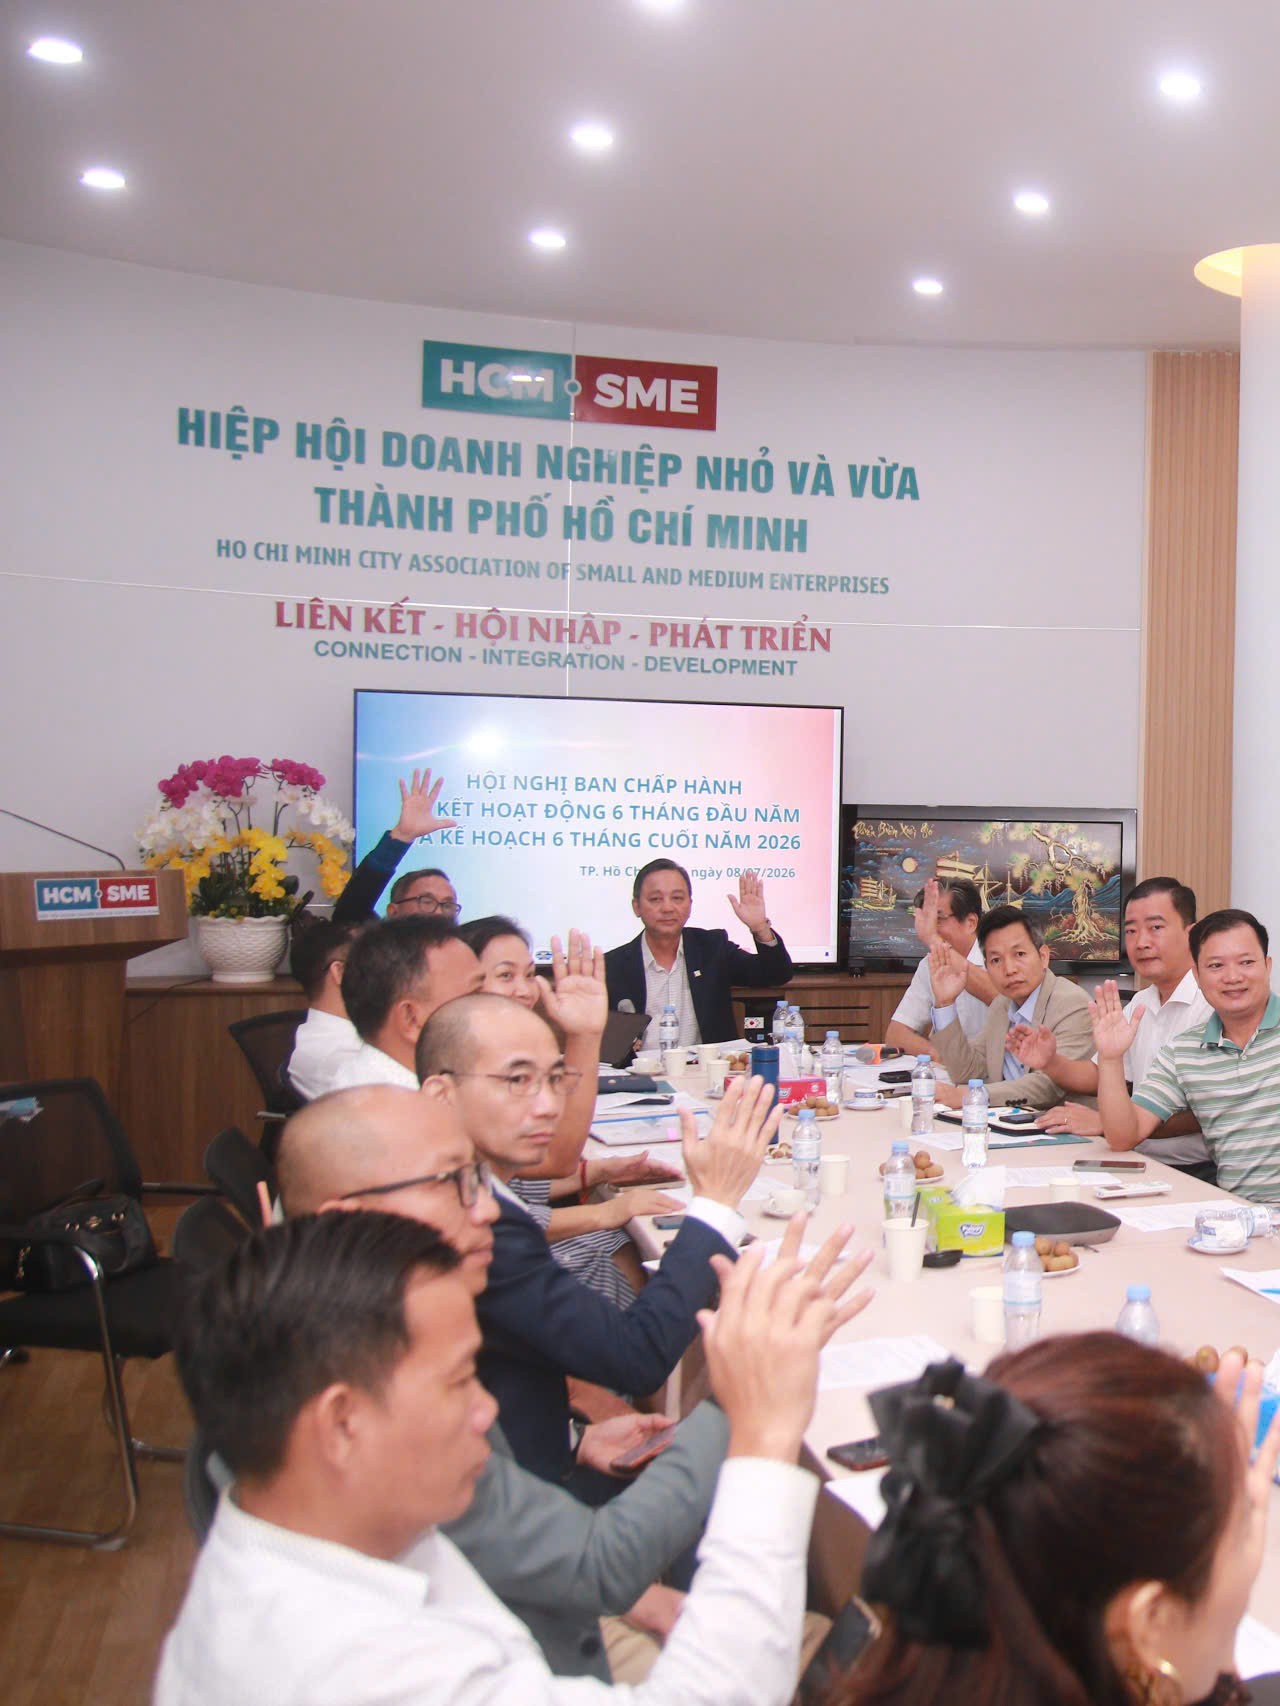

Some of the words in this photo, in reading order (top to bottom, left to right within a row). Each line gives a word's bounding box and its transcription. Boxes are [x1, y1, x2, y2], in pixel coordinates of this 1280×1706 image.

[440, 358, 555, 402] HCM
[593, 373, 699, 415] SME
[177, 405, 280, 460] HIỆP
[296, 417, 366, 472] HỘI
[382, 430, 522, 478] DOANH
[536, 443, 683, 494] NGHIỆP
[696, 446, 774, 494] NHỎ
[788, 454, 835, 497] VÀ
[848, 457, 920, 501] VỪA
[314, 482, 453, 533] THÀNH
[468, 493, 551, 538] PHỐ
[563, 495, 615, 542] HỒ
[628, 505, 694, 546] CHÍ
[706, 513, 808, 553] MINH
[217, 539, 246, 559] HO
[253, 542, 289, 563] CHI
[296, 546, 350, 567] MINH
[358, 550, 403, 571] CITY
[408, 554, 540, 579] ASSOCIATION
[546, 562, 570, 580] OF
[576, 564, 637, 584] SMALL
[642, 566, 683, 586] AND
[689, 569, 764, 590] MEDIUM
[769, 573, 890, 594] ENTERPRISES
[275, 596, 353, 633] LIÊN
[363, 596, 427, 636] KẾT
[455, 607, 519, 646] HỘI
[528, 611, 622, 650] NHẬP
[649, 616, 736, 650] PHÁT
[740, 614, 832, 652] TRIỂN
[314, 640, 463, 664] CONNECTION
[482, 648, 625, 671] INTEGRATION
[645, 655, 798, 676] DEVELOPMENT
[467, 770, 506, 793] HỘI
[513, 775, 568, 795] NGHỊ
[574, 776, 617, 793] BAN
[624, 773, 678, 794] CHẤP
[684, 776, 743, 795] HÀNH
[437, 796, 474, 817] KẾT
[481, 802, 539, 822] HOẠT
[544, 800, 606, 823] ĐỘNG
[612, 804, 624, 820] 6
[629, 802, 700, 821] THÁNG
[705, 802, 748, 822] ĐẦU
[754, 804, 800, 823] NĂM
[440, 825, 467, 845] KẾ
[472, 830, 546, 850] HOẠCH
[552, 831, 564, 847] 6
[570, 828, 641, 848] THÁNG
[648, 828, 698, 848] CUỐI
[705, 830, 751, 849] NĂM
[757, 834, 800, 849] 2026
[580, 866, 599, 876] TP.
[603, 866, 621, 877] Hồ
[691, 866, 723, 880] ngày
[43, 886, 91, 905] HCM
[107, 884, 151, 902] SME
